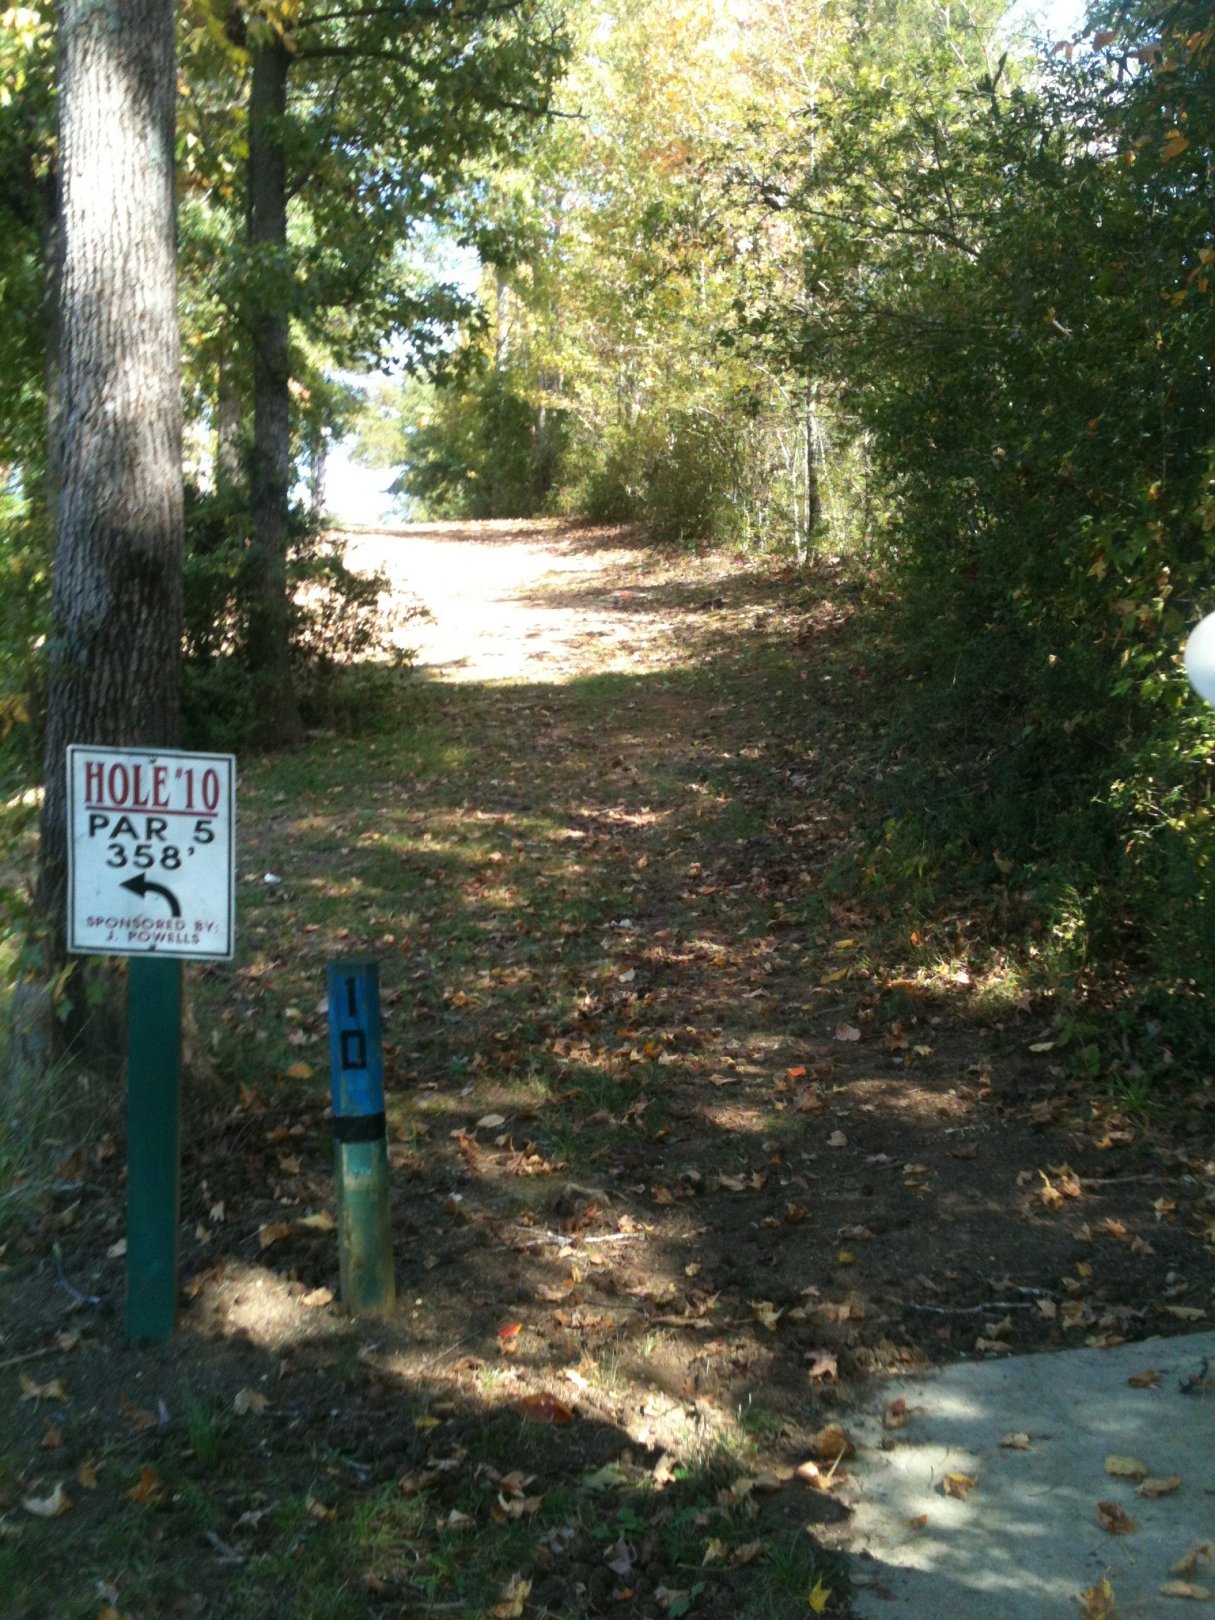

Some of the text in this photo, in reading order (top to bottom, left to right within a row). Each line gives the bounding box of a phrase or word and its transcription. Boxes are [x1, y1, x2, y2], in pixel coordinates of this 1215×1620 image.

[85, 761, 171, 808] HOLE
[89, 813, 215, 844] PAR 5
[106, 843, 195, 869] 358'
[86, 915, 185, 931] SPONSORED
[128, 931, 200, 944] POWELLS
